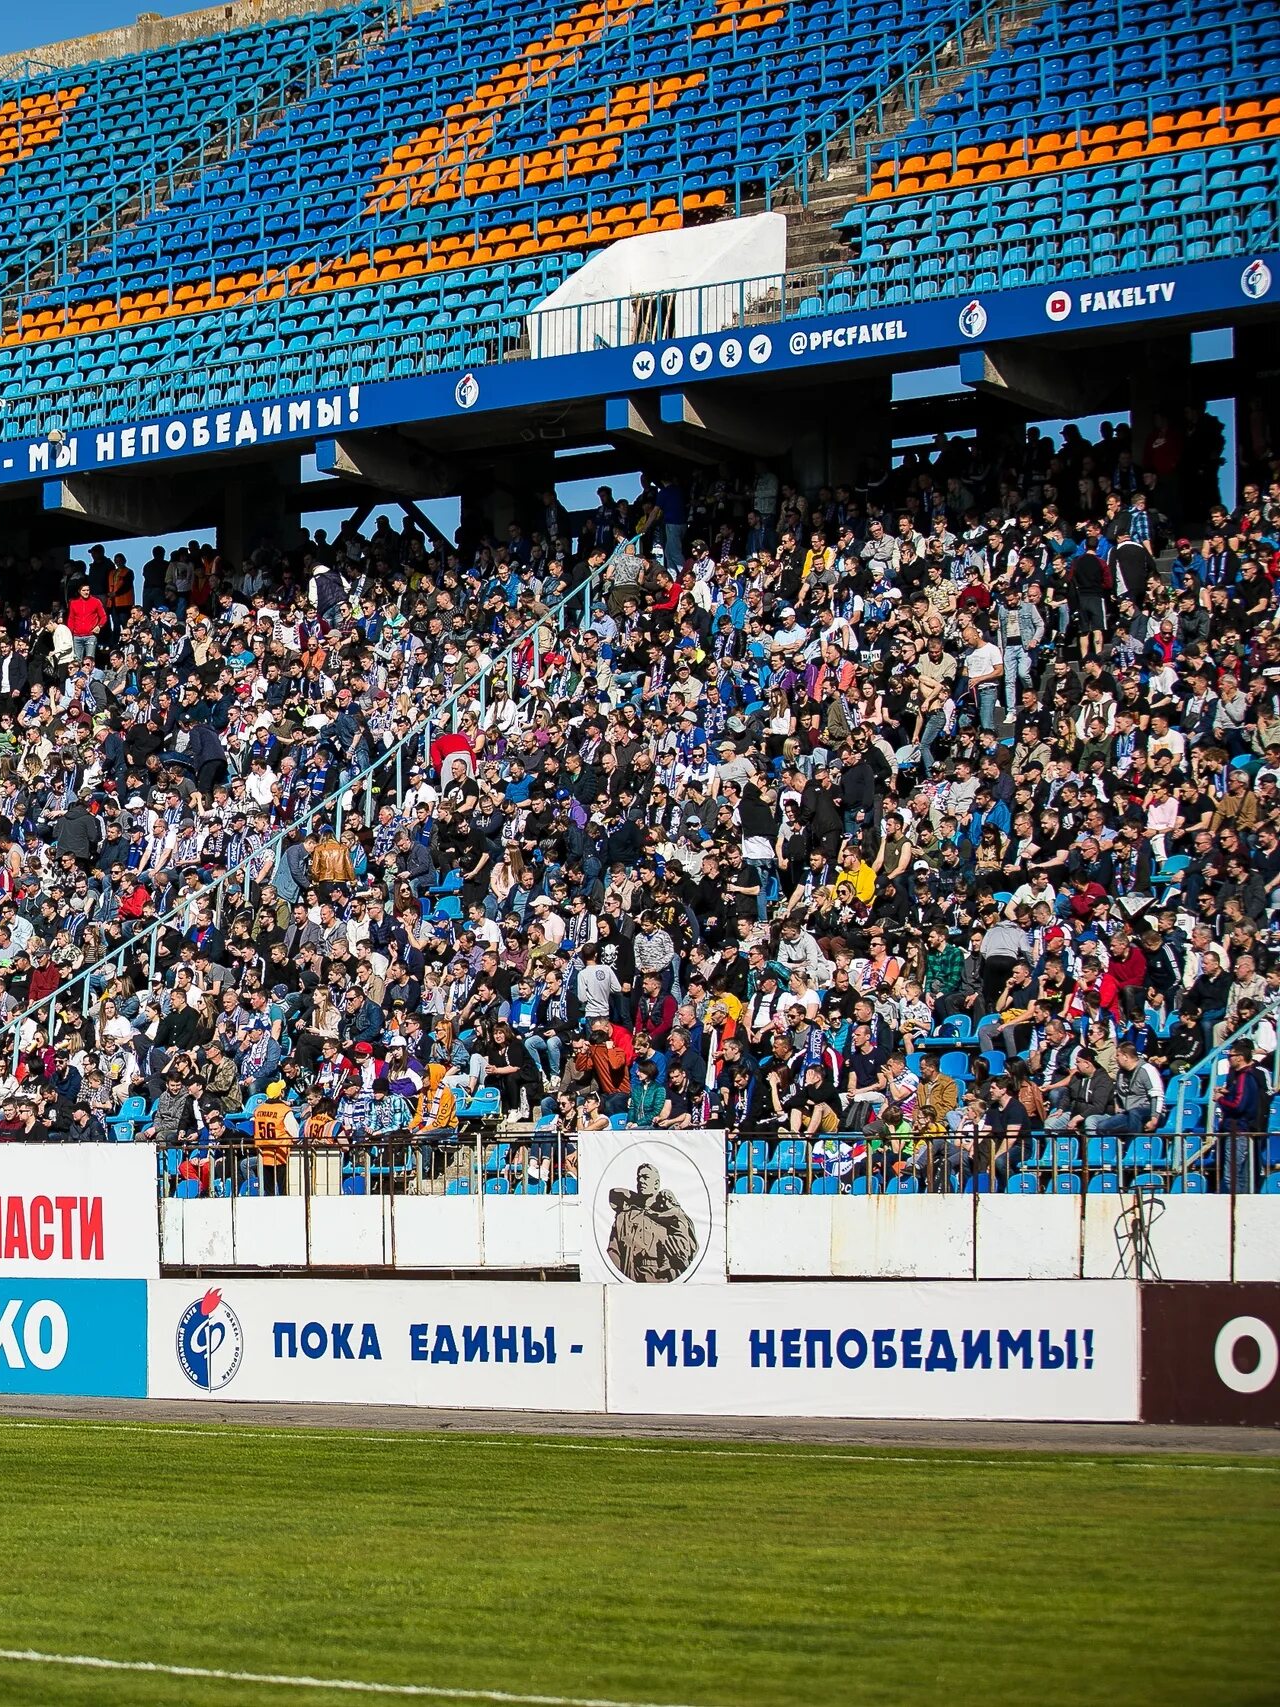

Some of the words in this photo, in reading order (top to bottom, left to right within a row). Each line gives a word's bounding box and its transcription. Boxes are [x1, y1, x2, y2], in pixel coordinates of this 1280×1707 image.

[1079, 281, 1176, 313] FAKELTV
[789, 320, 908, 355] @PFCFAKEL
[28, 437, 78, 474] МЫ
[95, 385, 361, 462] НЕПОБЕДИМЫ!
[258, 1121, 277, 1139] 56
[272, 1321, 382, 1360] ПОКА
[410, 1323, 557, 1365] ЕДИНЫ
[645, 1329, 718, 1368] МЫ
[749, 1328, 1095, 1372] НЕПОБЕДИМЫ!
[222, 1346, 240, 1382] ВОРОНЕЖ
